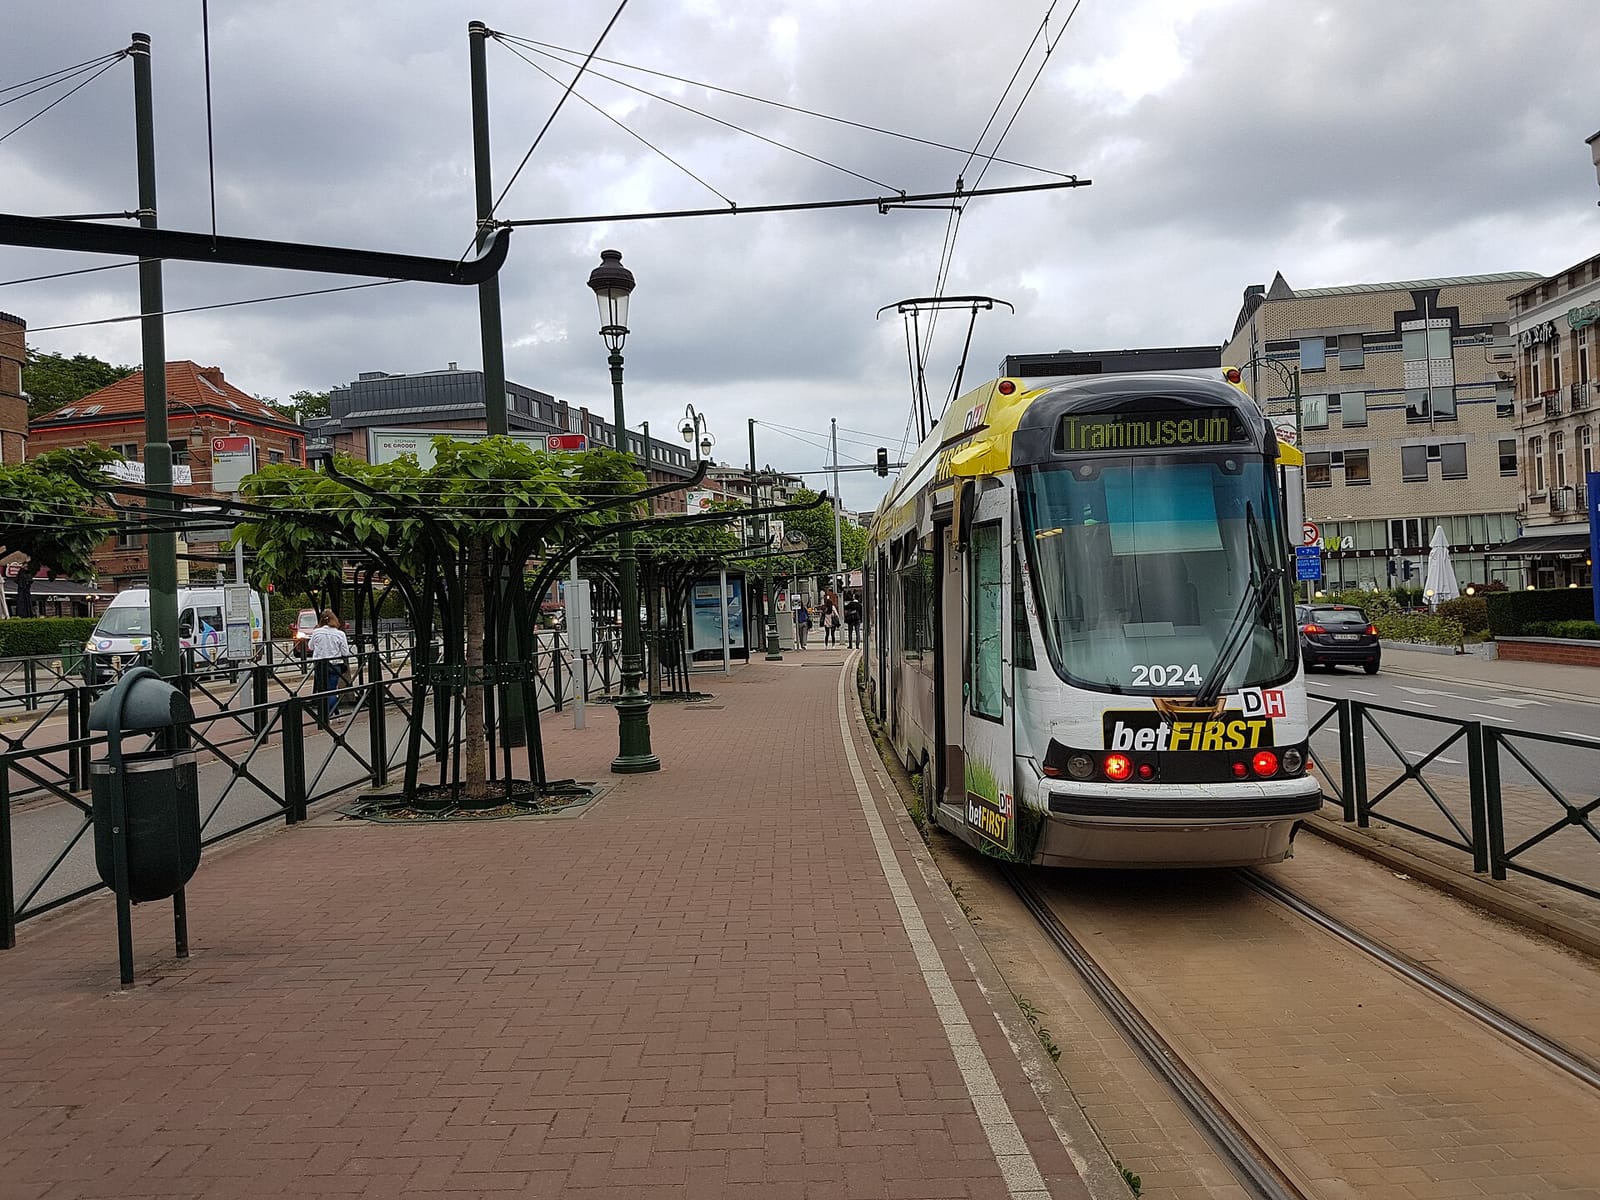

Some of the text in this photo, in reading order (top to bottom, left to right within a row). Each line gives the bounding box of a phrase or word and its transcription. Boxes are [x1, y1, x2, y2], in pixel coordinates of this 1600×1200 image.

[964, 406, 983, 431] DH
[1064, 416, 1229, 448] Trammuseum
[1131, 664, 1202, 687] 2024
[1241, 689, 1285, 716] DH
[1112, 720, 1267, 751] betFIRST
[1000, 792, 1012, 817] DH
[968, 799, 1007, 841] betFIRST
